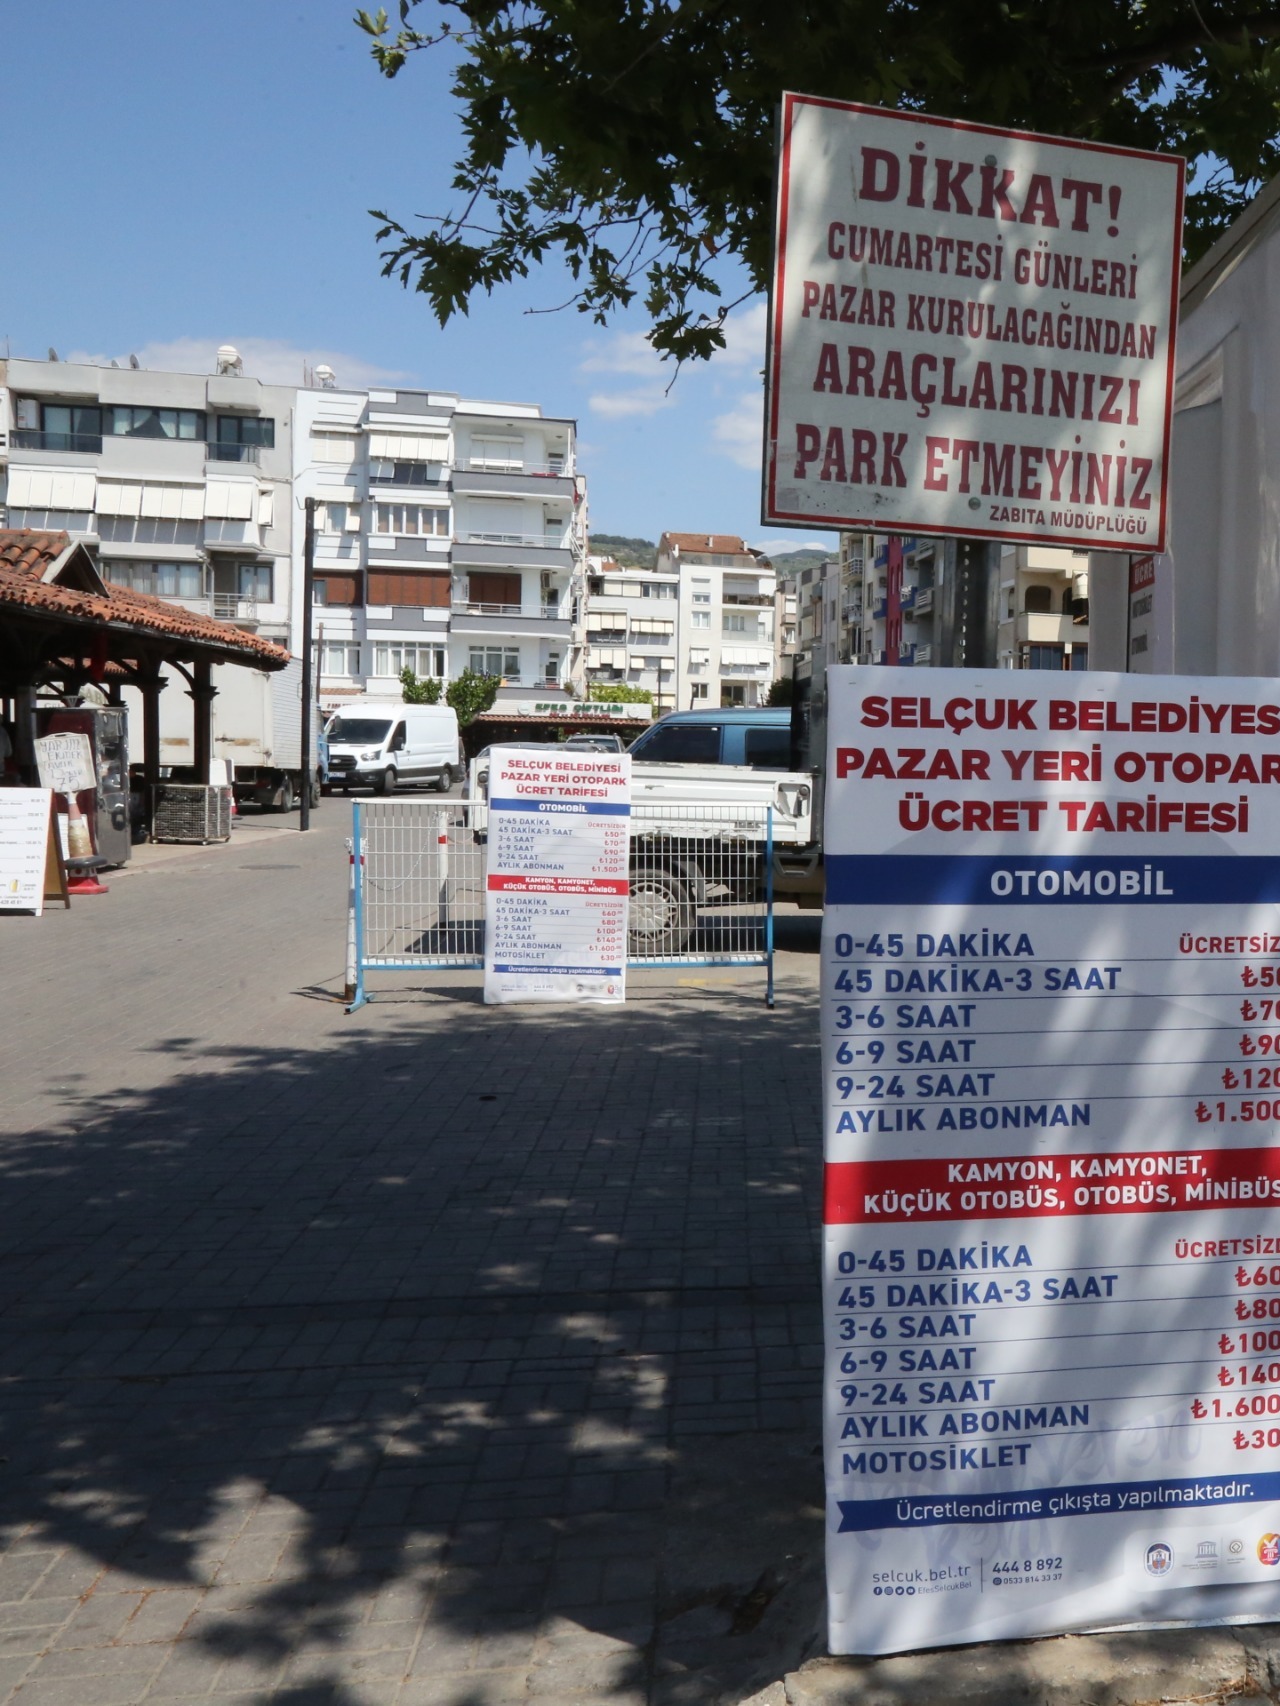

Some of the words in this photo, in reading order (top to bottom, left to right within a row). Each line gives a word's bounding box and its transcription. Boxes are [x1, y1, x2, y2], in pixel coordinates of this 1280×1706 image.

[859, 141, 1122, 237] DİKKAT!
[828, 222, 1002, 281] CUMARTESİ
[1014, 241, 1137, 299] GÜNLERİ
[802, 281, 895, 328] PAZAR
[907, 294, 1156, 359] KURULACAĞINDAN
[813, 343, 1141, 425] ARAÇLARINIZI
[794, 423, 907, 488] PARK
[924, 435, 1153, 510] ETMEYİNİZ
[990, 506, 1046, 525] ZABITA
[860, 696, 1037, 736] SELÇUK
[508, 760, 552, 770] SELÇUK
[556, 762, 621, 772] BELEDİYESİ
[836, 747, 990, 780] PAZAR
[1002, 743, 1101, 781] YERİ
[501, 772, 540, 781] PAZAR
[544, 774, 569, 783] YERİ
[573, 776, 626, 785] OTOPARK
[516, 784, 554, 795] ÜCRET
[558, 786, 607, 797] TARİFESİ
[539, 803, 587, 812] OTOMOBİL
[899, 793, 1048, 831] ÜCRET
[1059, 795, 1248, 833] TARİFESİ
[511, 826, 549, 835] DAKİKA-3
[520, 817, 550, 826] DAKİKA
[504, 883, 526, 891] KÜÇÜK
[528, 884, 556, 892] OTOBÜS,
[559, 885, 586, 893] OTOBÜS,
[558, 878, 595, 886] KAMYONET,
[990, 865, 1173, 896] OTOMOBİL
[517, 897, 547, 906] DAKİKA
[495, 951, 545, 959] MOTOSİKLET
[835, 933, 904, 957] 0-45
[916, 928, 1034, 957] DAKİKA
[835, 969, 872, 993] 45
[885, 964, 1032, 993] DAKİKA-3
[1044, 967, 1121, 991] SAAT
[836, 1006, 884, 1029] 3-6
[896, 1005, 976, 1028] SAAT
[836, 1041, 884, 1064] 6-9
[896, 1040, 976, 1063] SAAT
[836, 1076, 904, 1099] 9-24
[916, 1074, 994, 1097] SAAT
[836, 1109, 925, 1134] AYLIK
[936, 1104, 1090, 1131] ABONMAN
[948, 1160, 1062, 1184] KAMYON,
[1070, 1156, 1207, 1178] KAMYONET,
[864, 1187, 952, 1219] KÜÇÜK
[960, 1185, 1065, 1212] OTOBÜS,
[1074, 1181, 1177, 1208] OTOBÜS,
[838, 1249, 905, 1274] 0-45
[918, 1241, 1032, 1271] DAKİKA
[838, 1285, 875, 1309] 45
[887, 1277, 1031, 1307] DAKİKA-3
[1042, 1275, 1118, 1299] SAAT
[839, 1316, 887, 1340] 3-6
[899, 1314, 976, 1338] SAAT
[839, 1350, 887, 1374] 6-9
[899, 1347, 976, 1371] SAAT
[840, 1383, 907, 1407] 9-24
[918, 1380, 995, 1403] SAAT
[841, 1414, 928, 1439] AYLIK
[939, 1405, 1089, 1434] ABONMAN
[843, 1442, 1031, 1474] MOTOSİKLET
[897, 1496, 1042, 1521] Ücretlendirme
[1048, 1491, 1111, 1515] çıkışta
[1118, 1479, 1254, 1509] yapılmaktadır.
[873, 1565, 970, 1582] selcuk.bel.tr
[992, 1561, 1019, 1573] 444
[1023, 1560, 1032, 1572] 8
[1037, 1557, 1062, 1570] 892
[1003, 1576, 1023, 1584] 0533
[1053, 1573, 1062, 1581] 37
[918, 1581, 972, 1594] EfesSelcukBel
